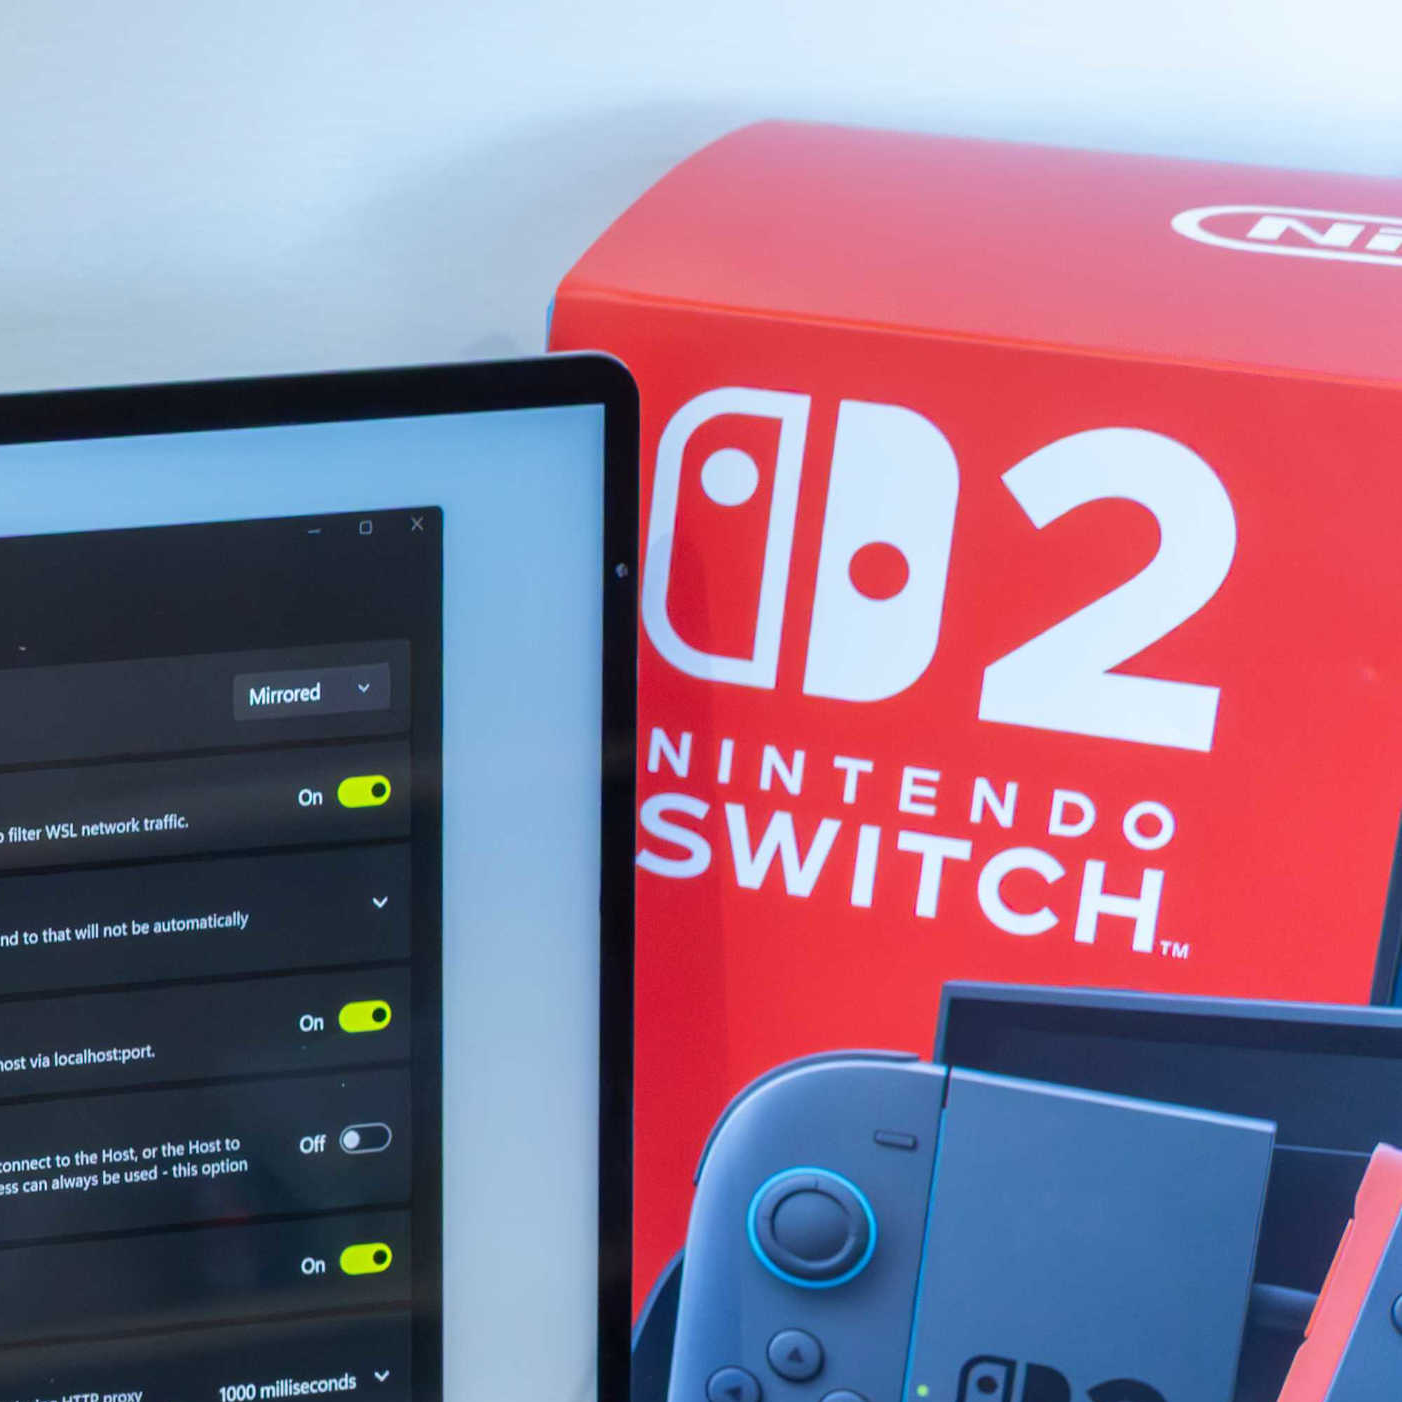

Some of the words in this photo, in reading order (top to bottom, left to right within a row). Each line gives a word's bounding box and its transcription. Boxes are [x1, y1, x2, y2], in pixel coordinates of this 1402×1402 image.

[979, 428, 1236, 752] 2
[249, 682, 321, 706] Mirrored
[299, 789, 322, 806] On
[644, 724, 1179, 854] NINTENDO
[8, 826, 42, 843] filter
[45, 823, 78, 840] WSL
[81, 817, 140, 837] network
[143, 813, 189, 831] traffic.
[637, 792, 1163, 953] SWITCH
[300, 1015, 323, 1031] On
[300, 1135, 326, 1153] Off
[301, 1258, 325, 1274] On
[260, 1372, 357, 1399] milliseconds
